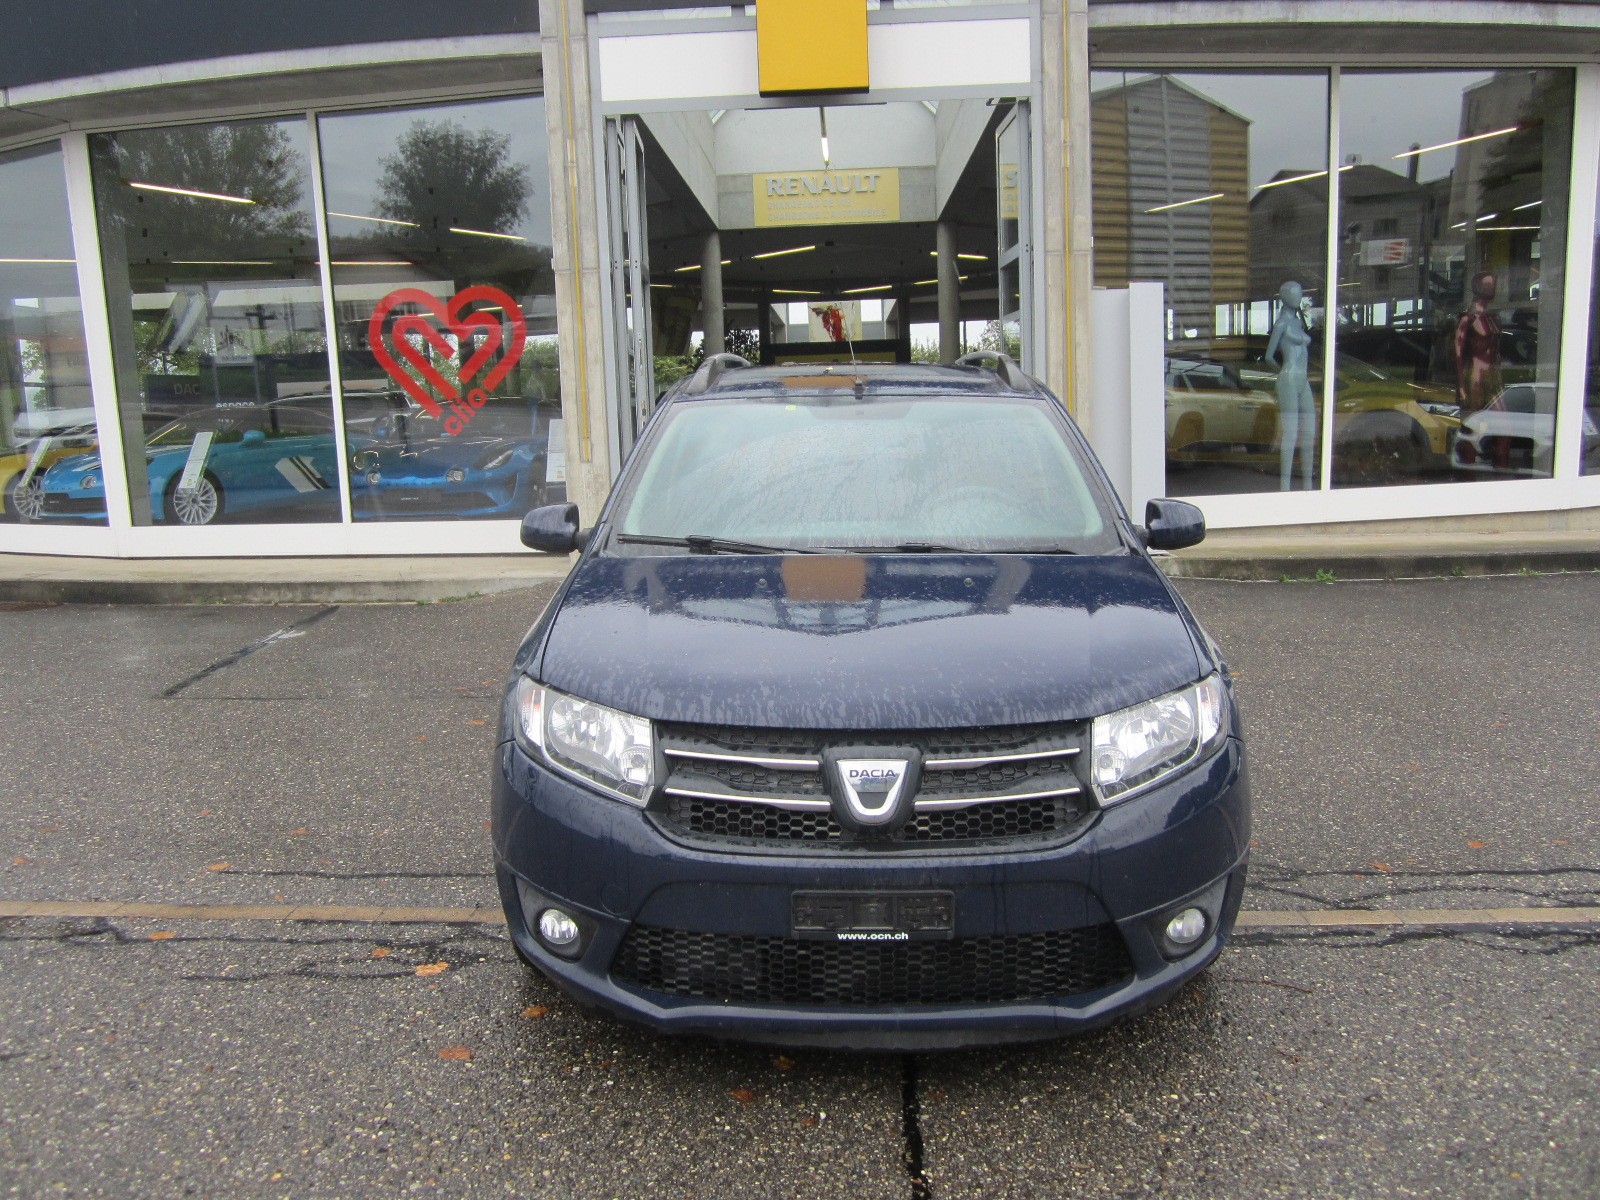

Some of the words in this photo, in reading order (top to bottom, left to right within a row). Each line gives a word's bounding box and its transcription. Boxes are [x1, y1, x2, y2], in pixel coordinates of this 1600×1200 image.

[766, 173, 880, 197] RENAULT
[444, 388, 487, 436] clio
[849, 769, 896, 778] DACIA
[837, 932, 909, 940] www.ocn.ch
